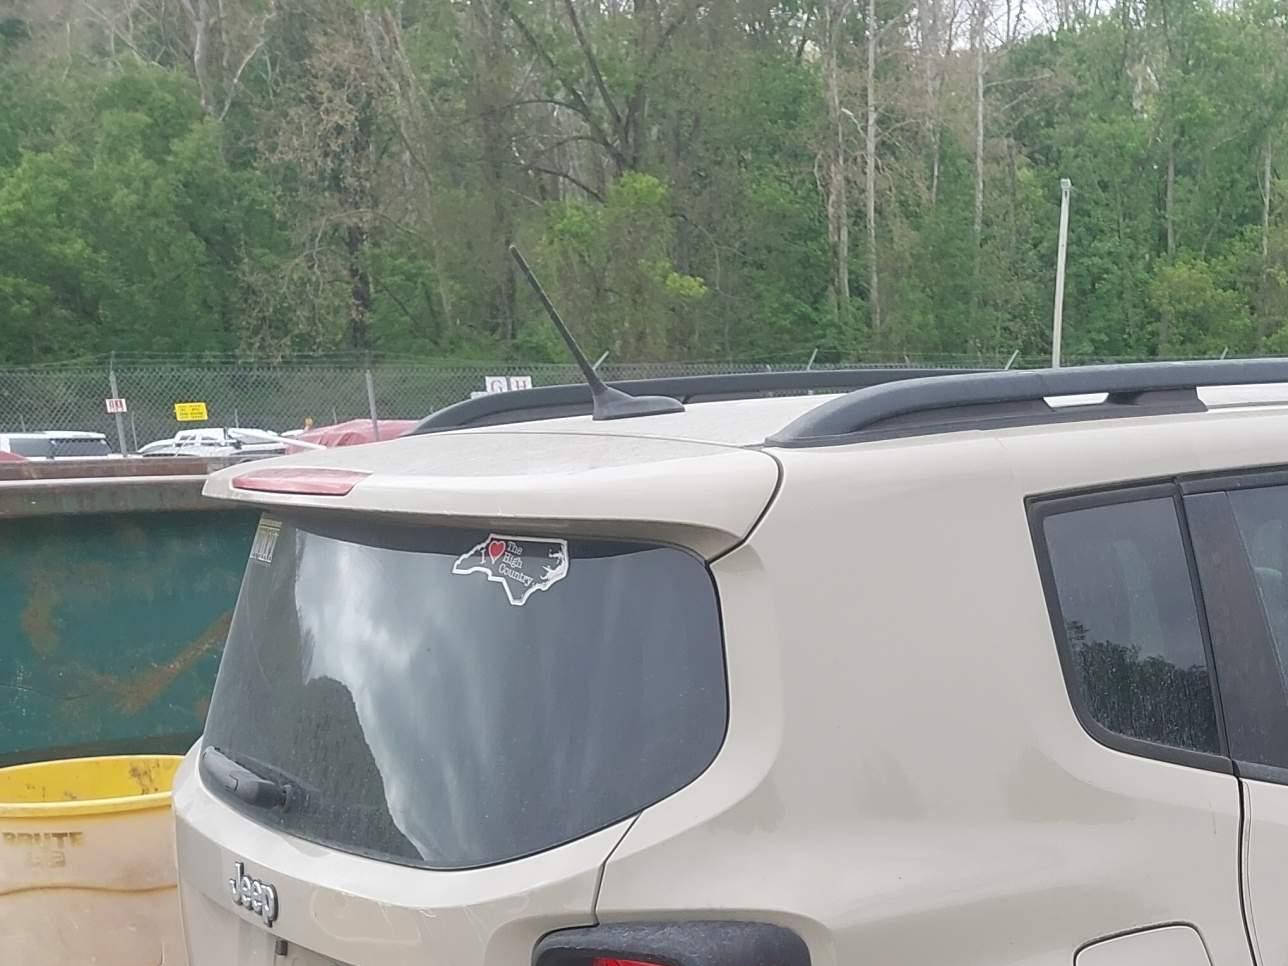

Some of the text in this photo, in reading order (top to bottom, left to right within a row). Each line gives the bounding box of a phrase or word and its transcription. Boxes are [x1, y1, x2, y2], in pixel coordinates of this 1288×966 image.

[506, 541, 524, 556] The
[502, 553, 523, 569] High
[498, 563, 534, 587] Country
[228, 862, 279, 928] Jeep
